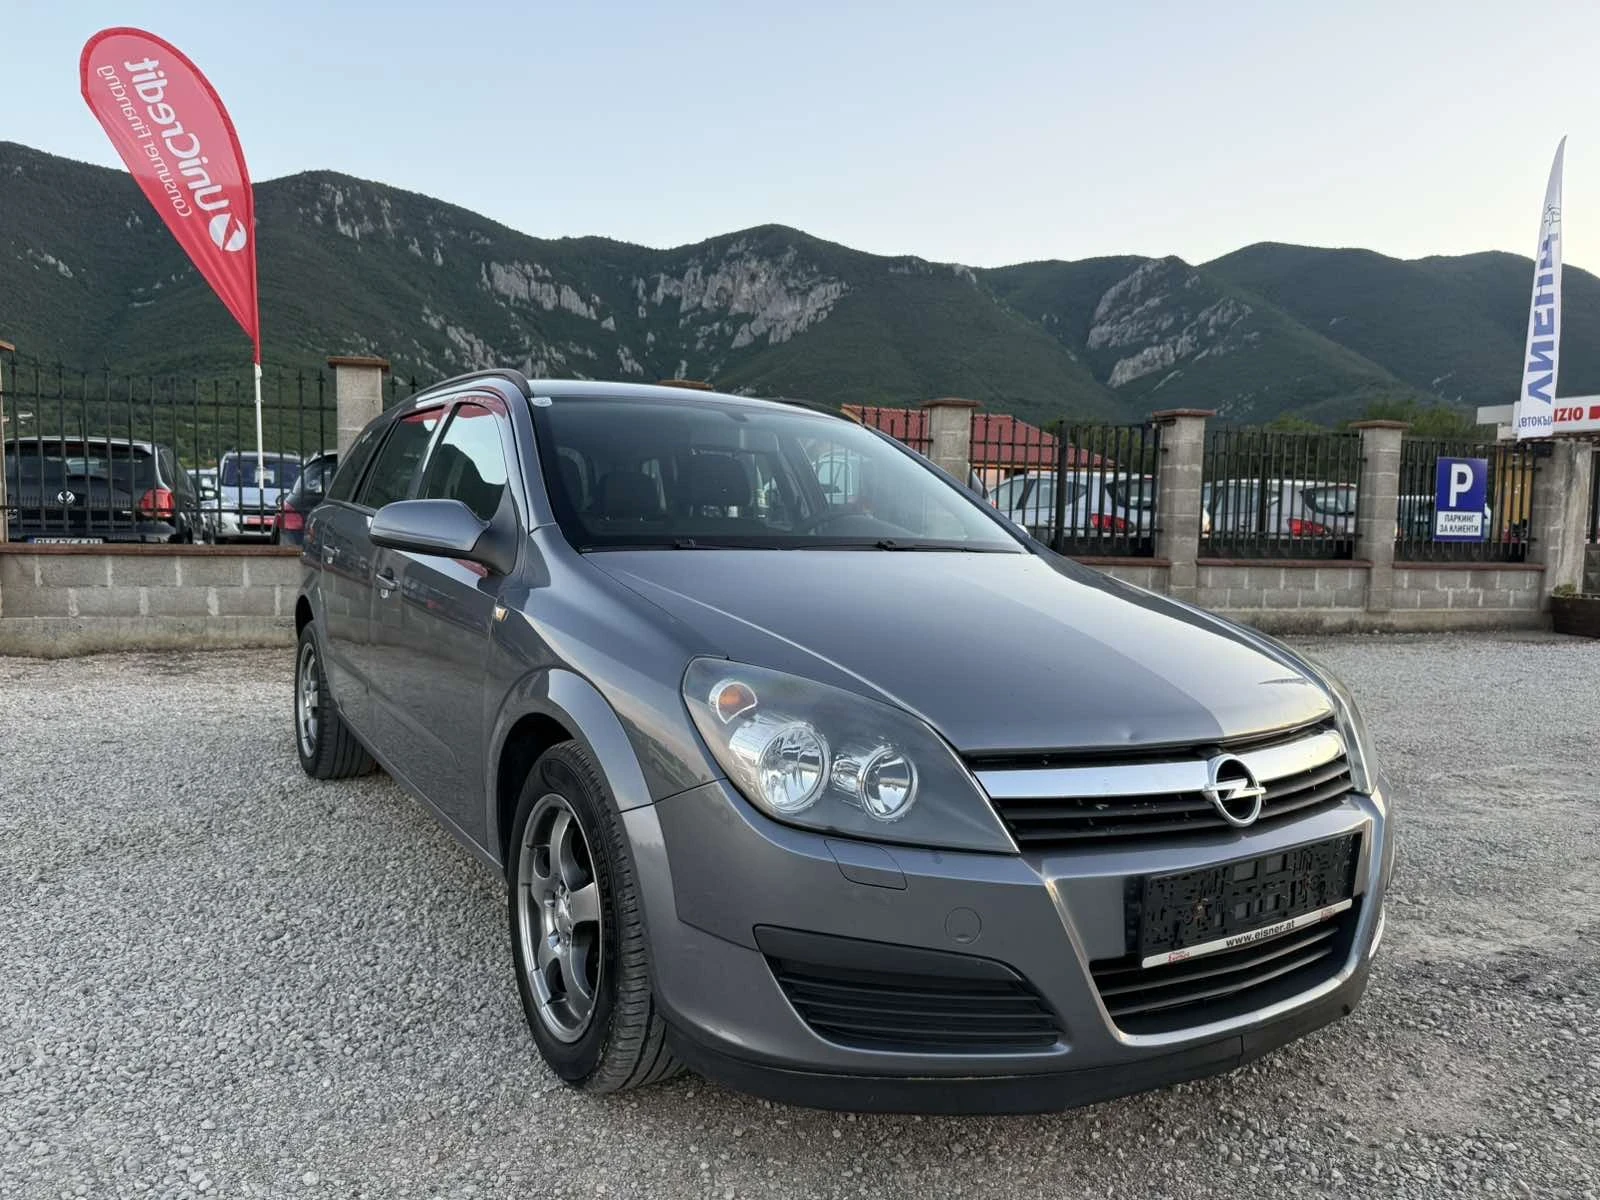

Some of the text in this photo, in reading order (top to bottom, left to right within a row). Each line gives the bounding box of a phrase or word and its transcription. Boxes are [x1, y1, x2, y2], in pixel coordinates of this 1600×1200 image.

[1449, 463, 1473, 507] P
[1444, 513, 1475, 523] ПАРКИНГ
[1439, 523, 1479, 534] ЗА КЛИЕНТИ
[1226, 919, 1295, 947] www.eisner.at
